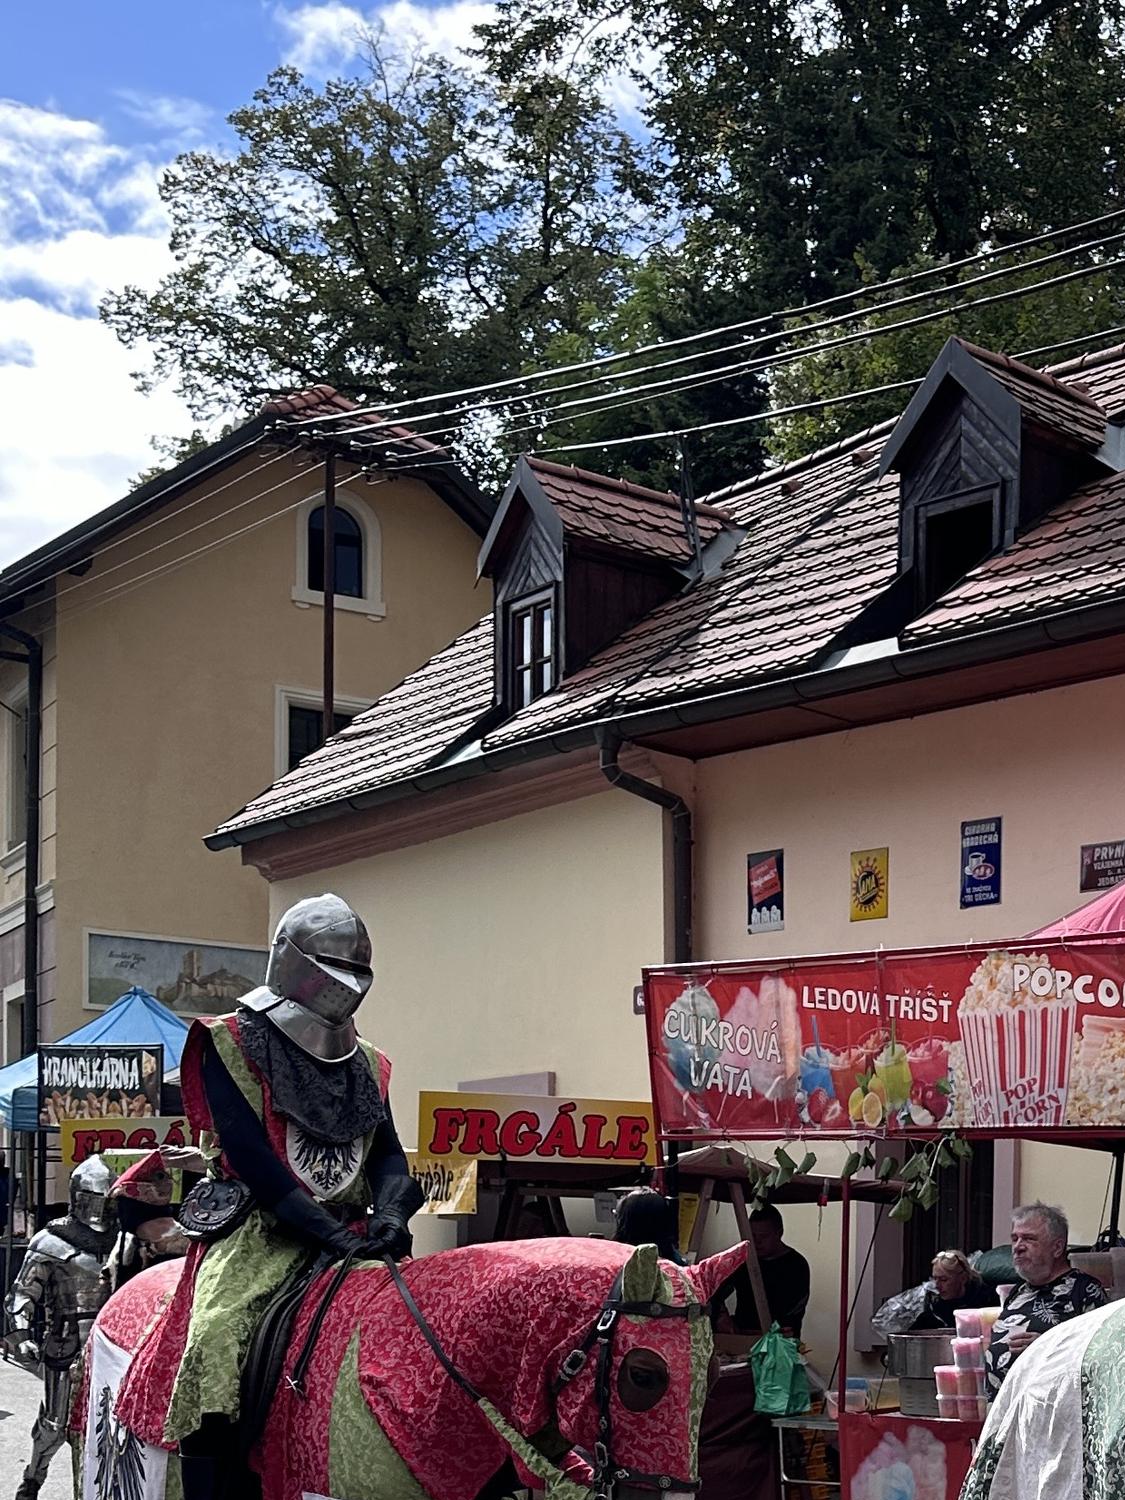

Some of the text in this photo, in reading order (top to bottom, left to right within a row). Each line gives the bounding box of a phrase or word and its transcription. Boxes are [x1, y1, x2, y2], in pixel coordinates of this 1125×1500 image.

[802, 985, 953, 1023] LEDOVÁ TŘÍŠŤ
[663, 1009, 782, 1064] CUKROVÁ
[689, 1056, 752, 1100] VATA
[1003, 1077, 1038, 1106] POP
[1013, 1089, 1062, 1124] CORN
[71, 1119, 200, 1162] FRGÁ
[429, 1101, 649, 1160] FRGÁLE
